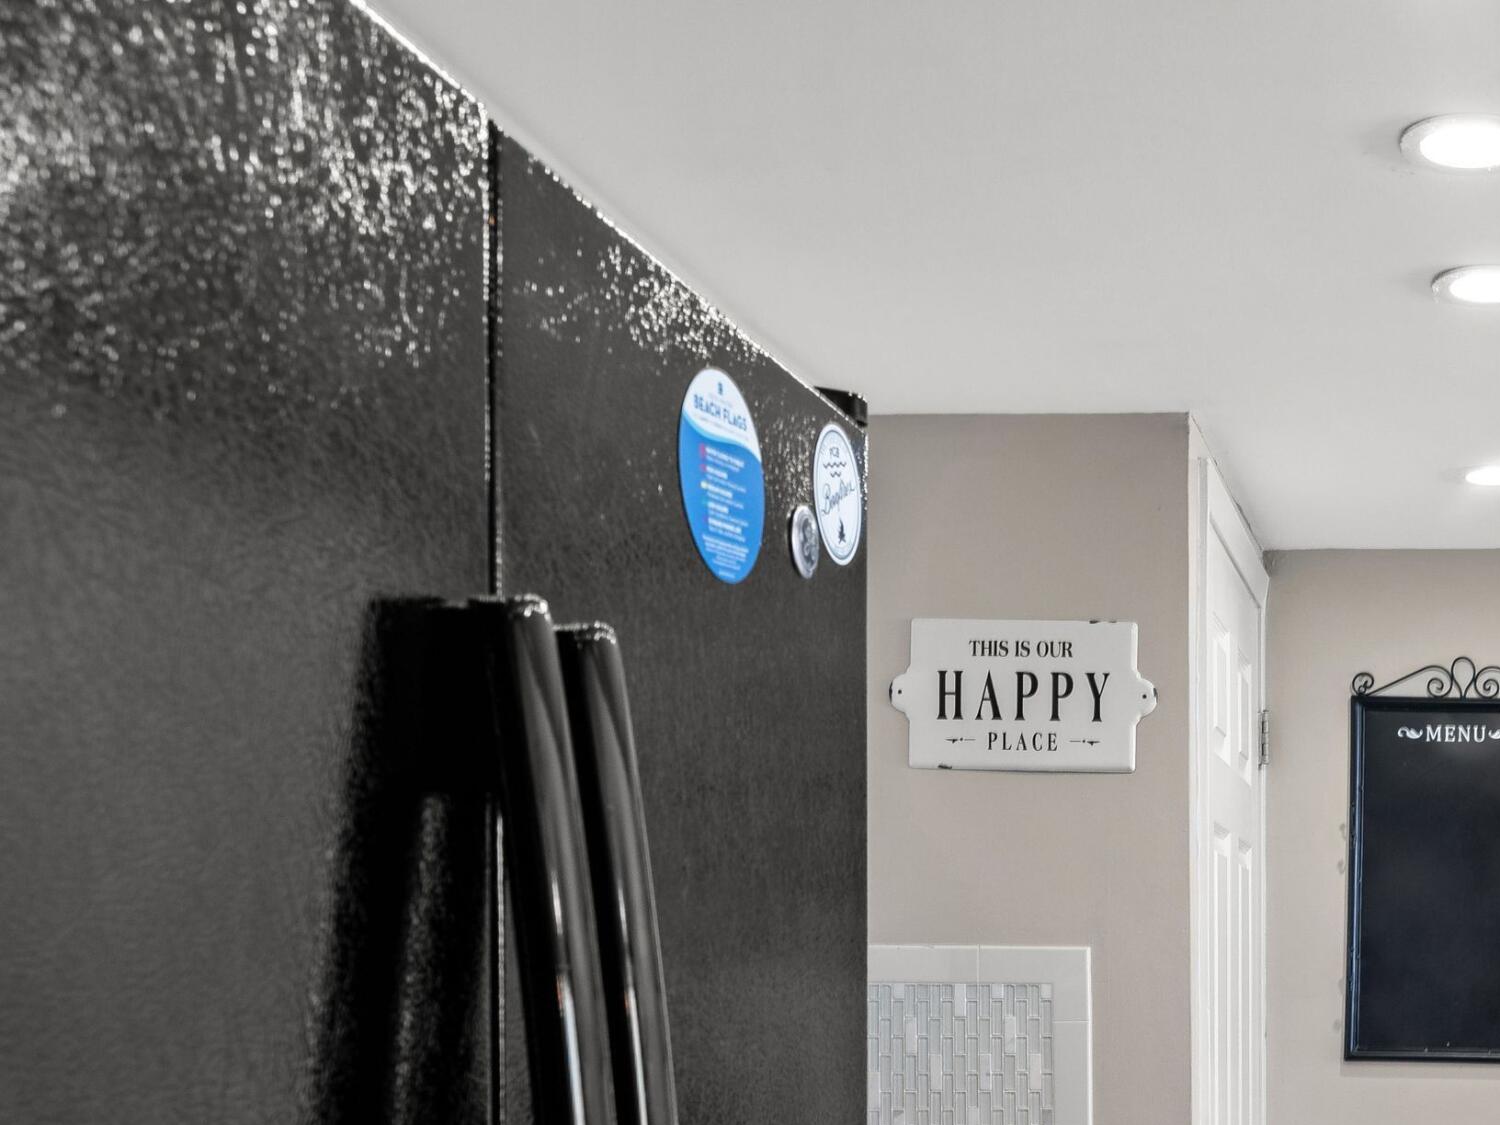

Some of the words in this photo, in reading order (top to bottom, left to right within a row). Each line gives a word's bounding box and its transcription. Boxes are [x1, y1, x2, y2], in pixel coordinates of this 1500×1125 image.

[969, 640, 1009, 657] THIS
[1014, 641, 1031, 657] IS
[1036, 641, 1073, 658] OUR
[936, 669, 1110, 722] HAPPY
[987, 732, 1058, 751] PLACE
[1425, 725, 1487, 743] MENU
